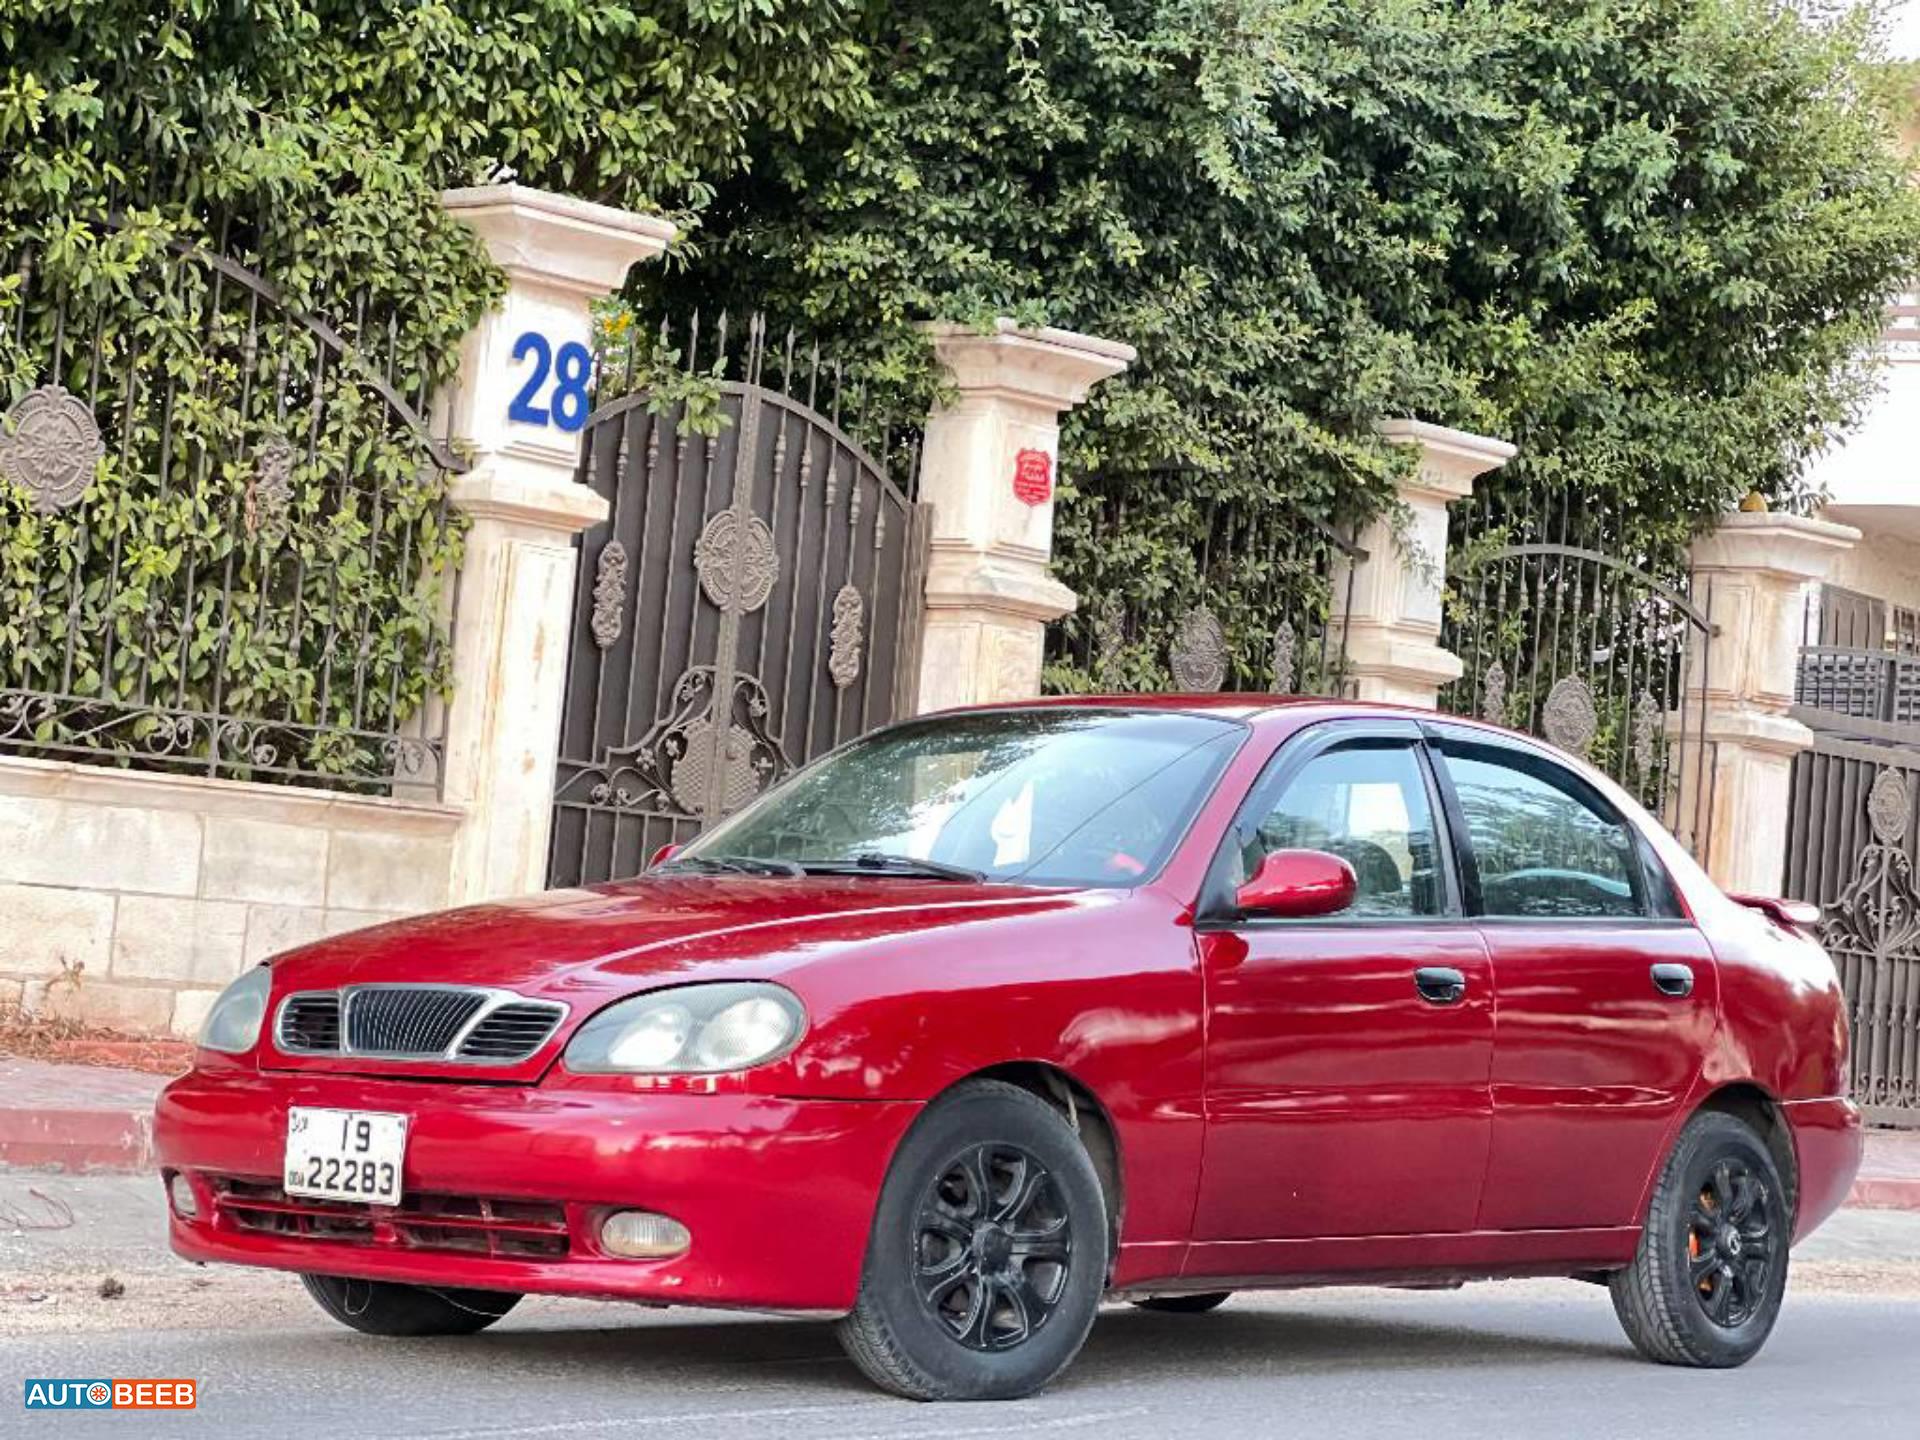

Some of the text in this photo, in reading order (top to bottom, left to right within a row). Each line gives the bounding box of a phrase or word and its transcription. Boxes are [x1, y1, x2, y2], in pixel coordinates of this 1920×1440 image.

[508, 332, 591, 432] 28
[341, 1119, 370, 1152] 19
[307, 1156, 394, 1195] 22283
